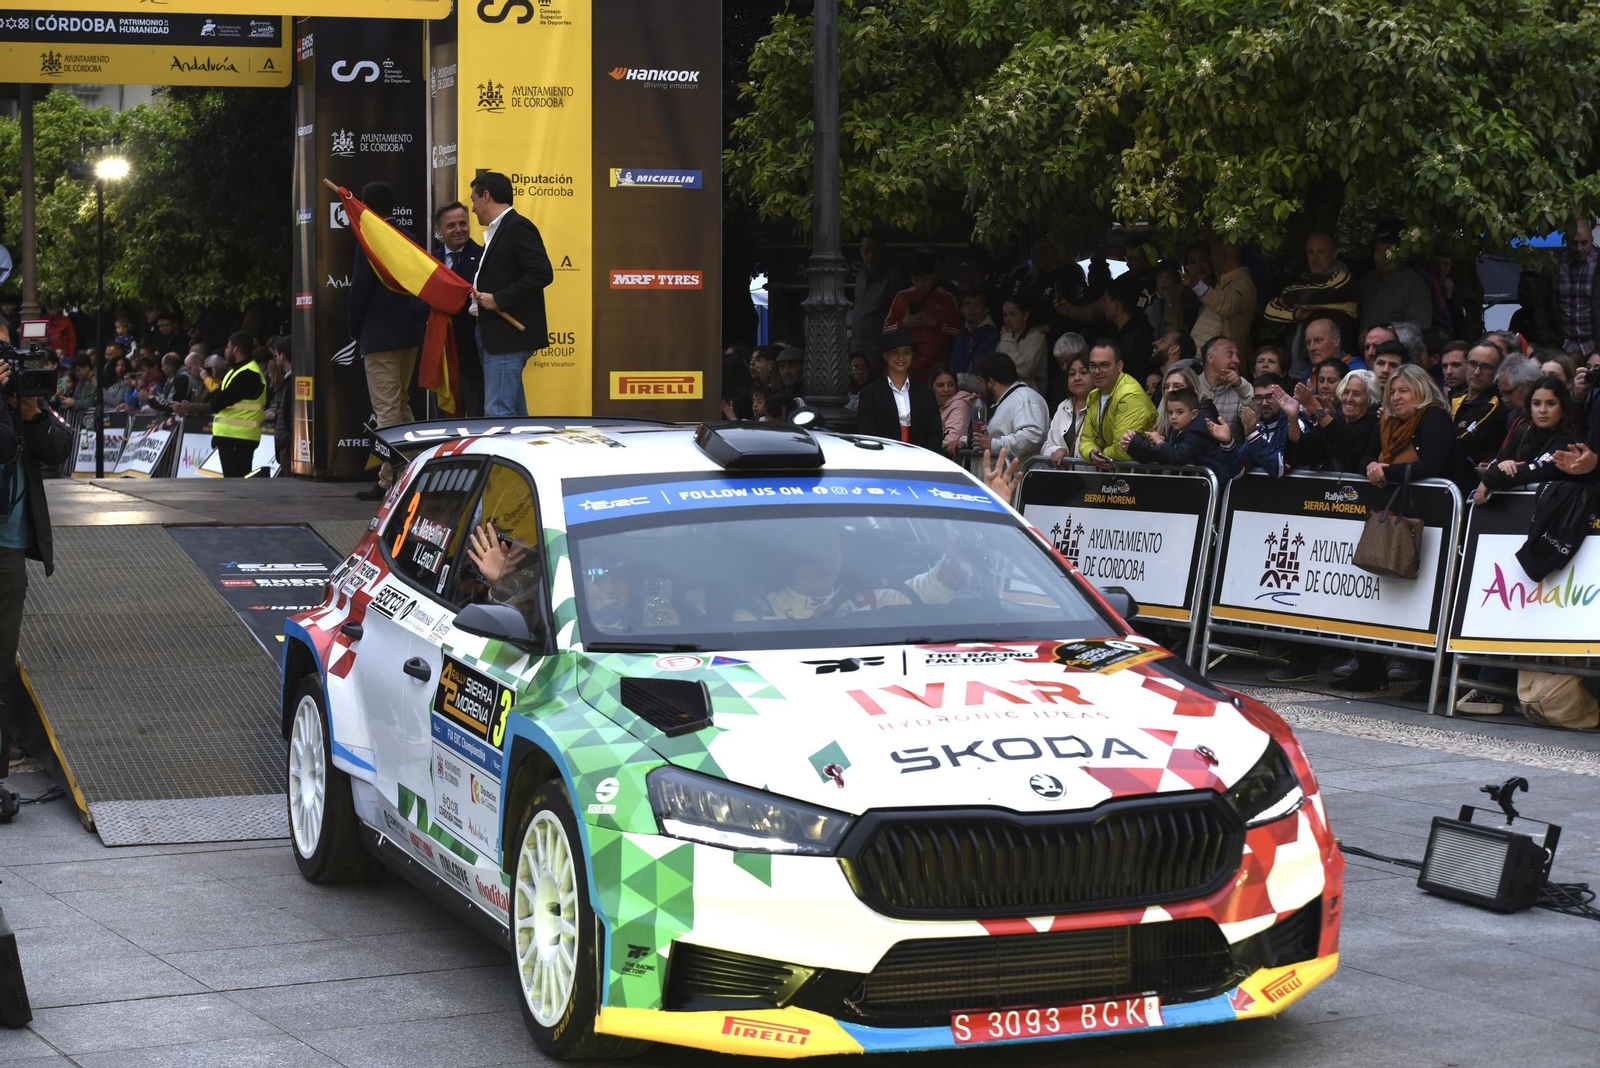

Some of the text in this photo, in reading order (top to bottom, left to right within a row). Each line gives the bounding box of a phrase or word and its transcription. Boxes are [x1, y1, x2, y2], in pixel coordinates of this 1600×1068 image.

[35, 15, 117, 33] CÓRDOBA
[119, 18, 164, 27] PATRIMONIO
[119, 26, 169, 34] HUMANIDAD
[64, 55, 109, 63] AYUNTAMIENTO
[170, 55, 240, 74] Andalucía
[64, 63, 102, 72] DE CÓRDOBA
[512, 86, 574, 97] AYUNTAMIENTO
[643, 81, 668, 90] driving
[512, 96, 564, 108] DE CÓRDOBA
[360, 133, 413, 143] AYUNTAMIENTO
[360, 142, 404, 152] DE CÓRDOBA
[511, 173, 573, 185] Diputación
[636, 174, 695, 184] MICHELIN
[526, 185, 573, 197] Córdoba
[612, 274, 700, 285] MRF TYRES
[540, 347, 575, 357] GROUP
[533, 361, 550, 369] Flight
[618, 377, 695, 394] PIRELLI
[679, 486, 804, 501] FOLLOW US ON
[1084, 493, 1136, 506] SIERRA MORENA
[1325, 491, 1345, 503] Rallye
[1303, 500, 1367, 515] SIERRA MORENA
[391, 491, 421, 559] 3
[1087, 528, 1163, 554] AYUNTAMIENTO
[1309, 539, 1354, 566] AYUNTA
[1082, 555, 1145, 581] DE CORDOBA
[1305, 569, 1380, 600] DE CORDOBA
[451, 669, 493, 705] RALLY SIERRA
[845, 679, 1096, 716] IVAR
[455, 693, 489, 725] MORENA
[492, 689, 512, 747] 3
[878, 711, 1110, 731] HYDRONIC IDEAS
[1260, 969, 1303, 1004] PIRELLI
[955, 998, 1144, 1041] S 3093 BCK
[721, 1016, 811, 1046] PIRELLI
